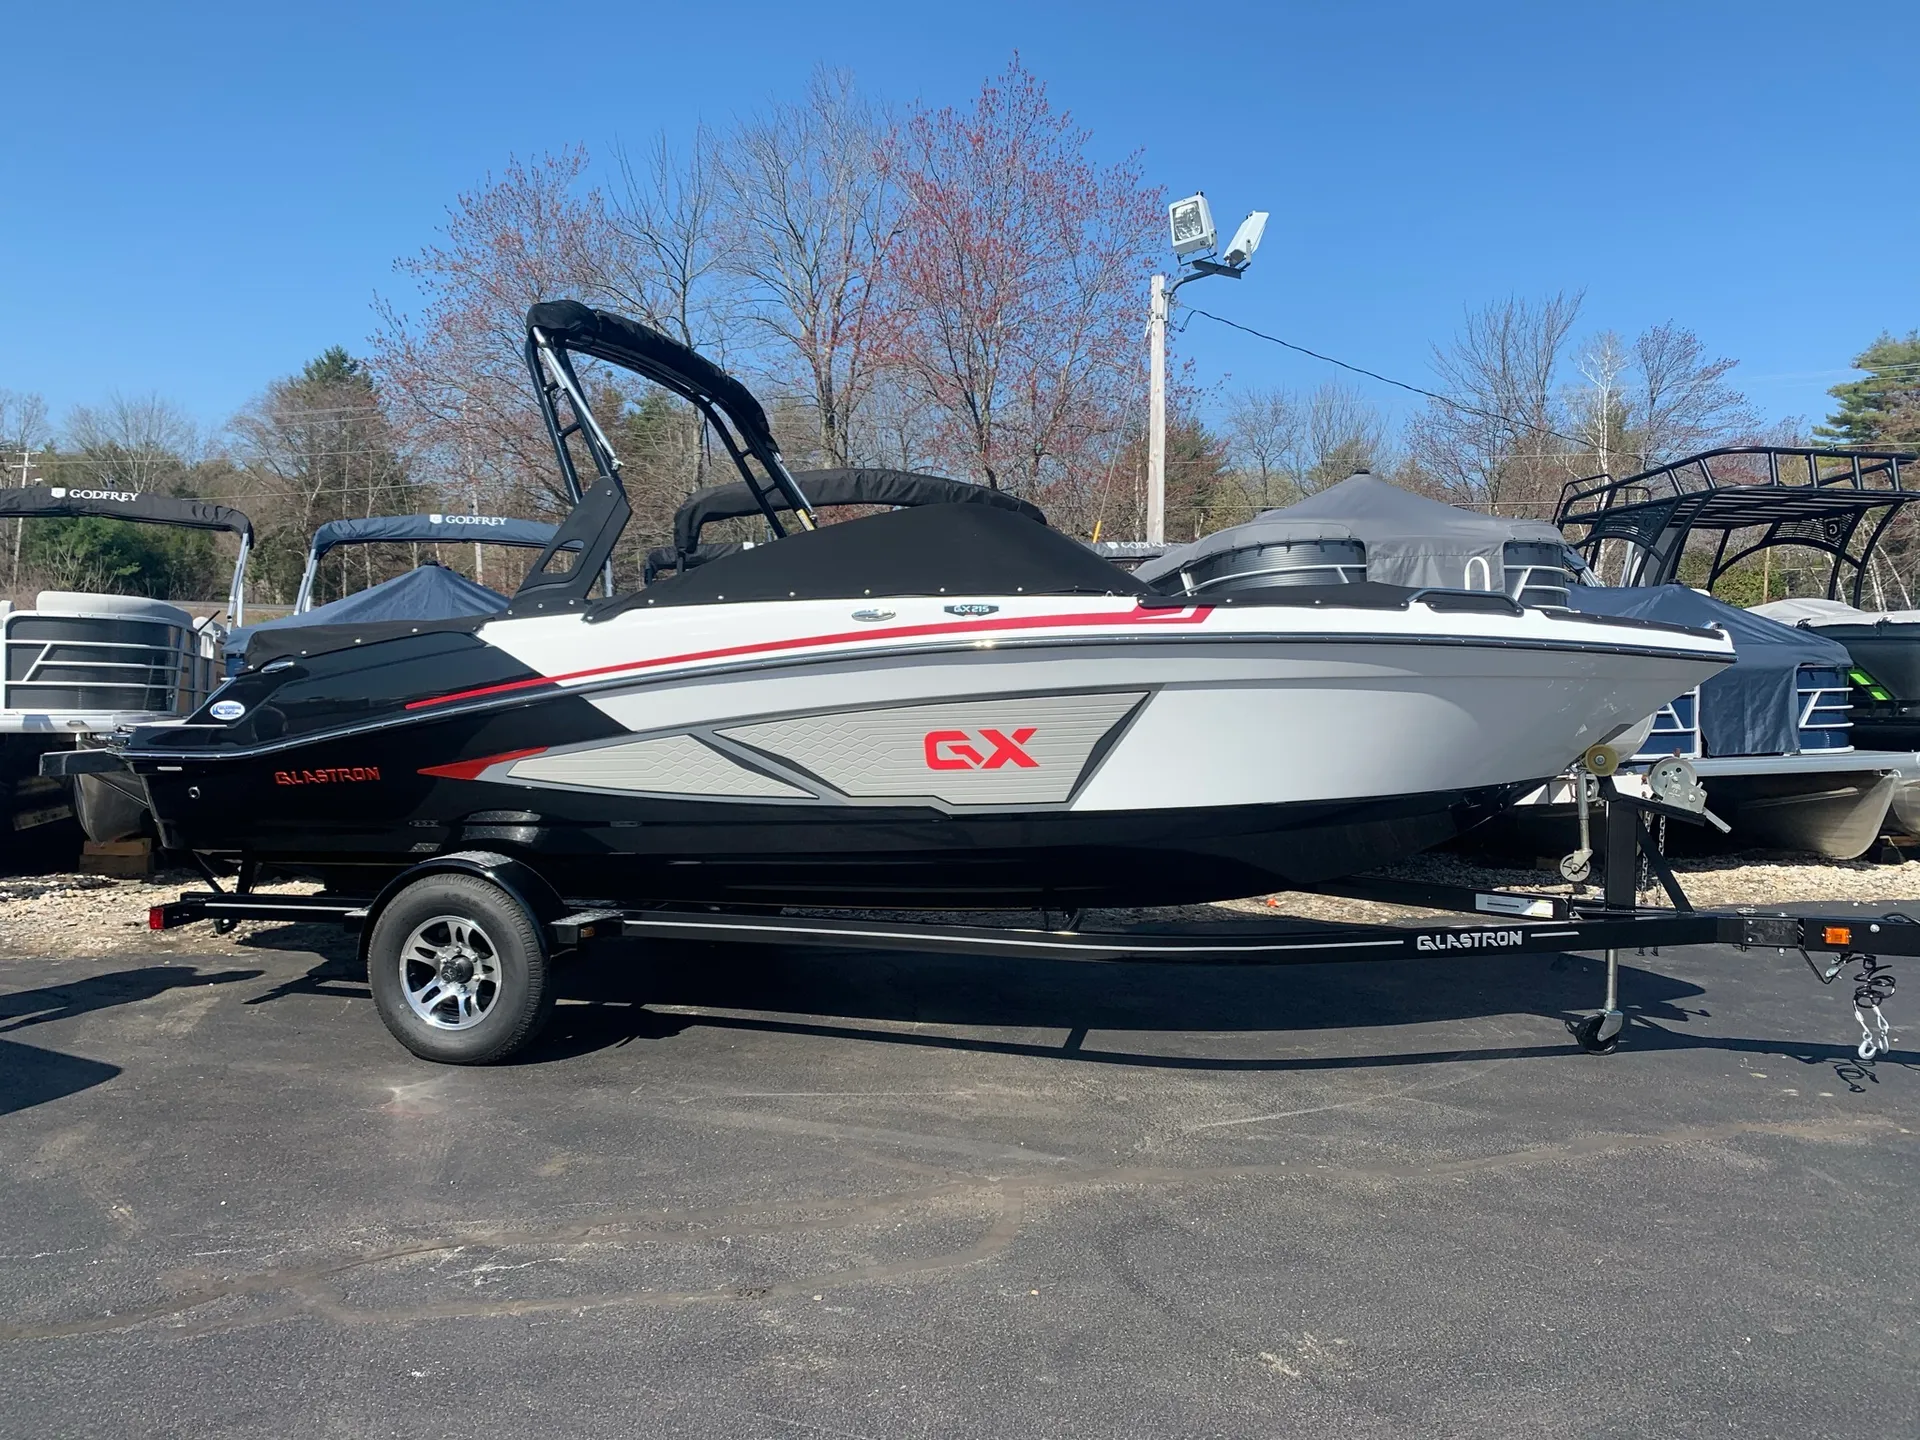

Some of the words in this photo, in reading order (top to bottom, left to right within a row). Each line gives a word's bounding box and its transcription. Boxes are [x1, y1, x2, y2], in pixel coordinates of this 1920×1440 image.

[69, 489, 139, 502] GODFREY
[445, 515, 507, 526] GODFREY
[924, 728, 1040, 770] GX
[274, 767, 380, 785] GLASTRON
[1416, 930, 1523, 951] GLASTRON
